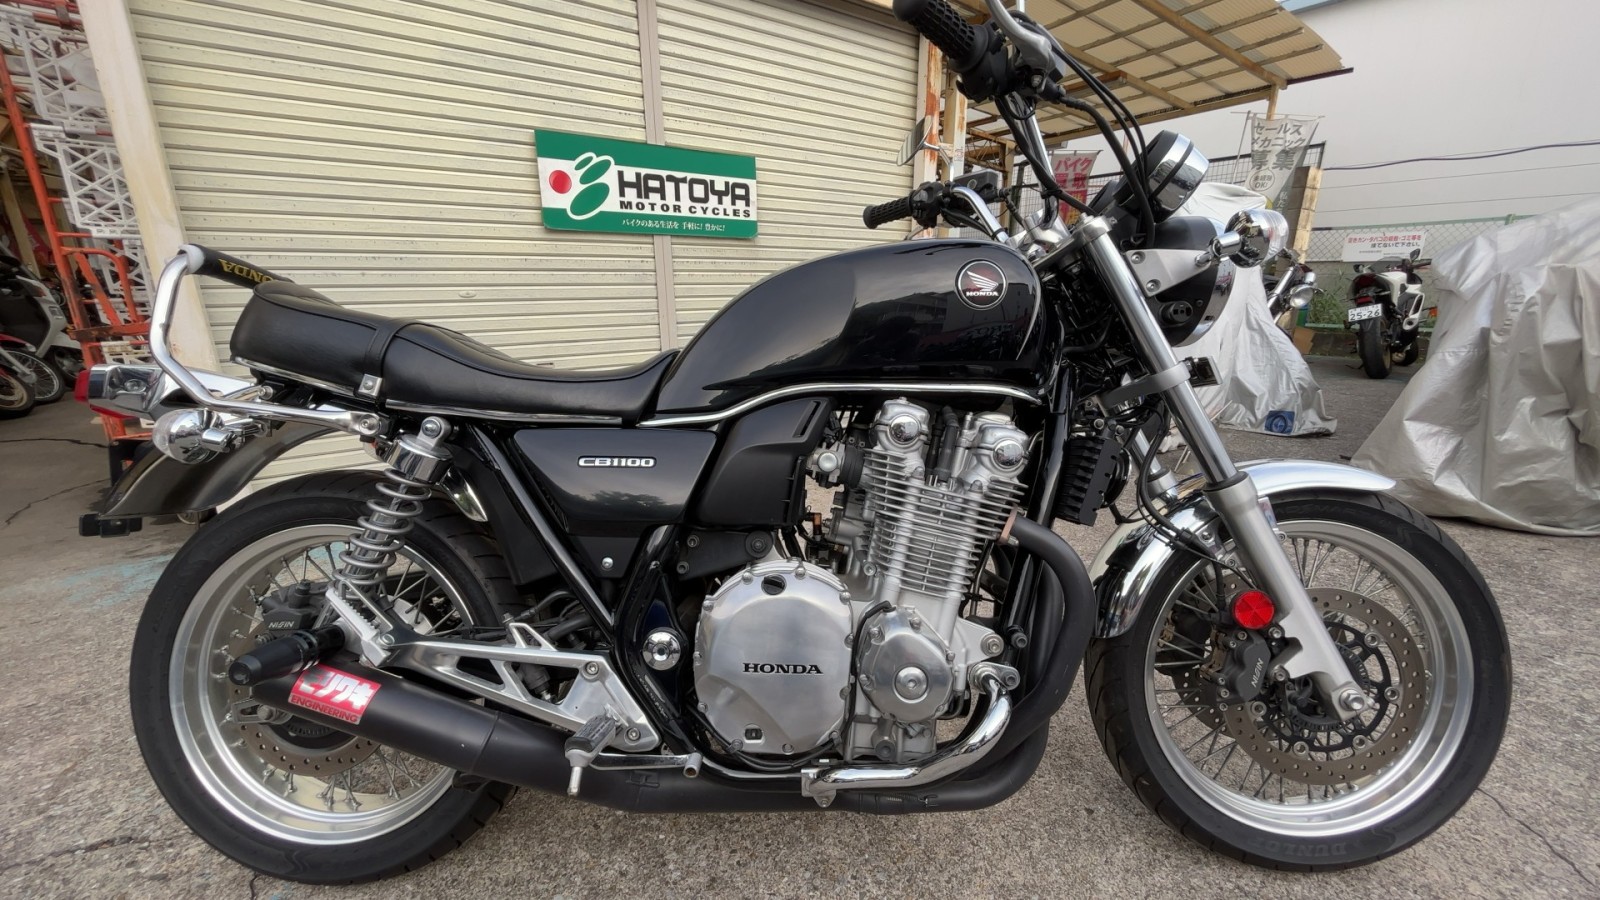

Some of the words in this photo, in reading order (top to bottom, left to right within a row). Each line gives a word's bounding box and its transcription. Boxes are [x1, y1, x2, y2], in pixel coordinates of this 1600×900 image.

[1253, 122, 1303, 136] セールス
[1251, 136, 1306, 149] メカニック
[617, 170, 751, 208] HATOYA
[619, 200, 682, 214] MOTOR
[688, 205, 751, 218] CYCLES
[622, 218, 680, 230] バイクのある生活を
[578, 457, 655, 468] CB1100
[742, 662, 824, 675] HONDA
[288, 695, 359, 723] ENGINEERING
